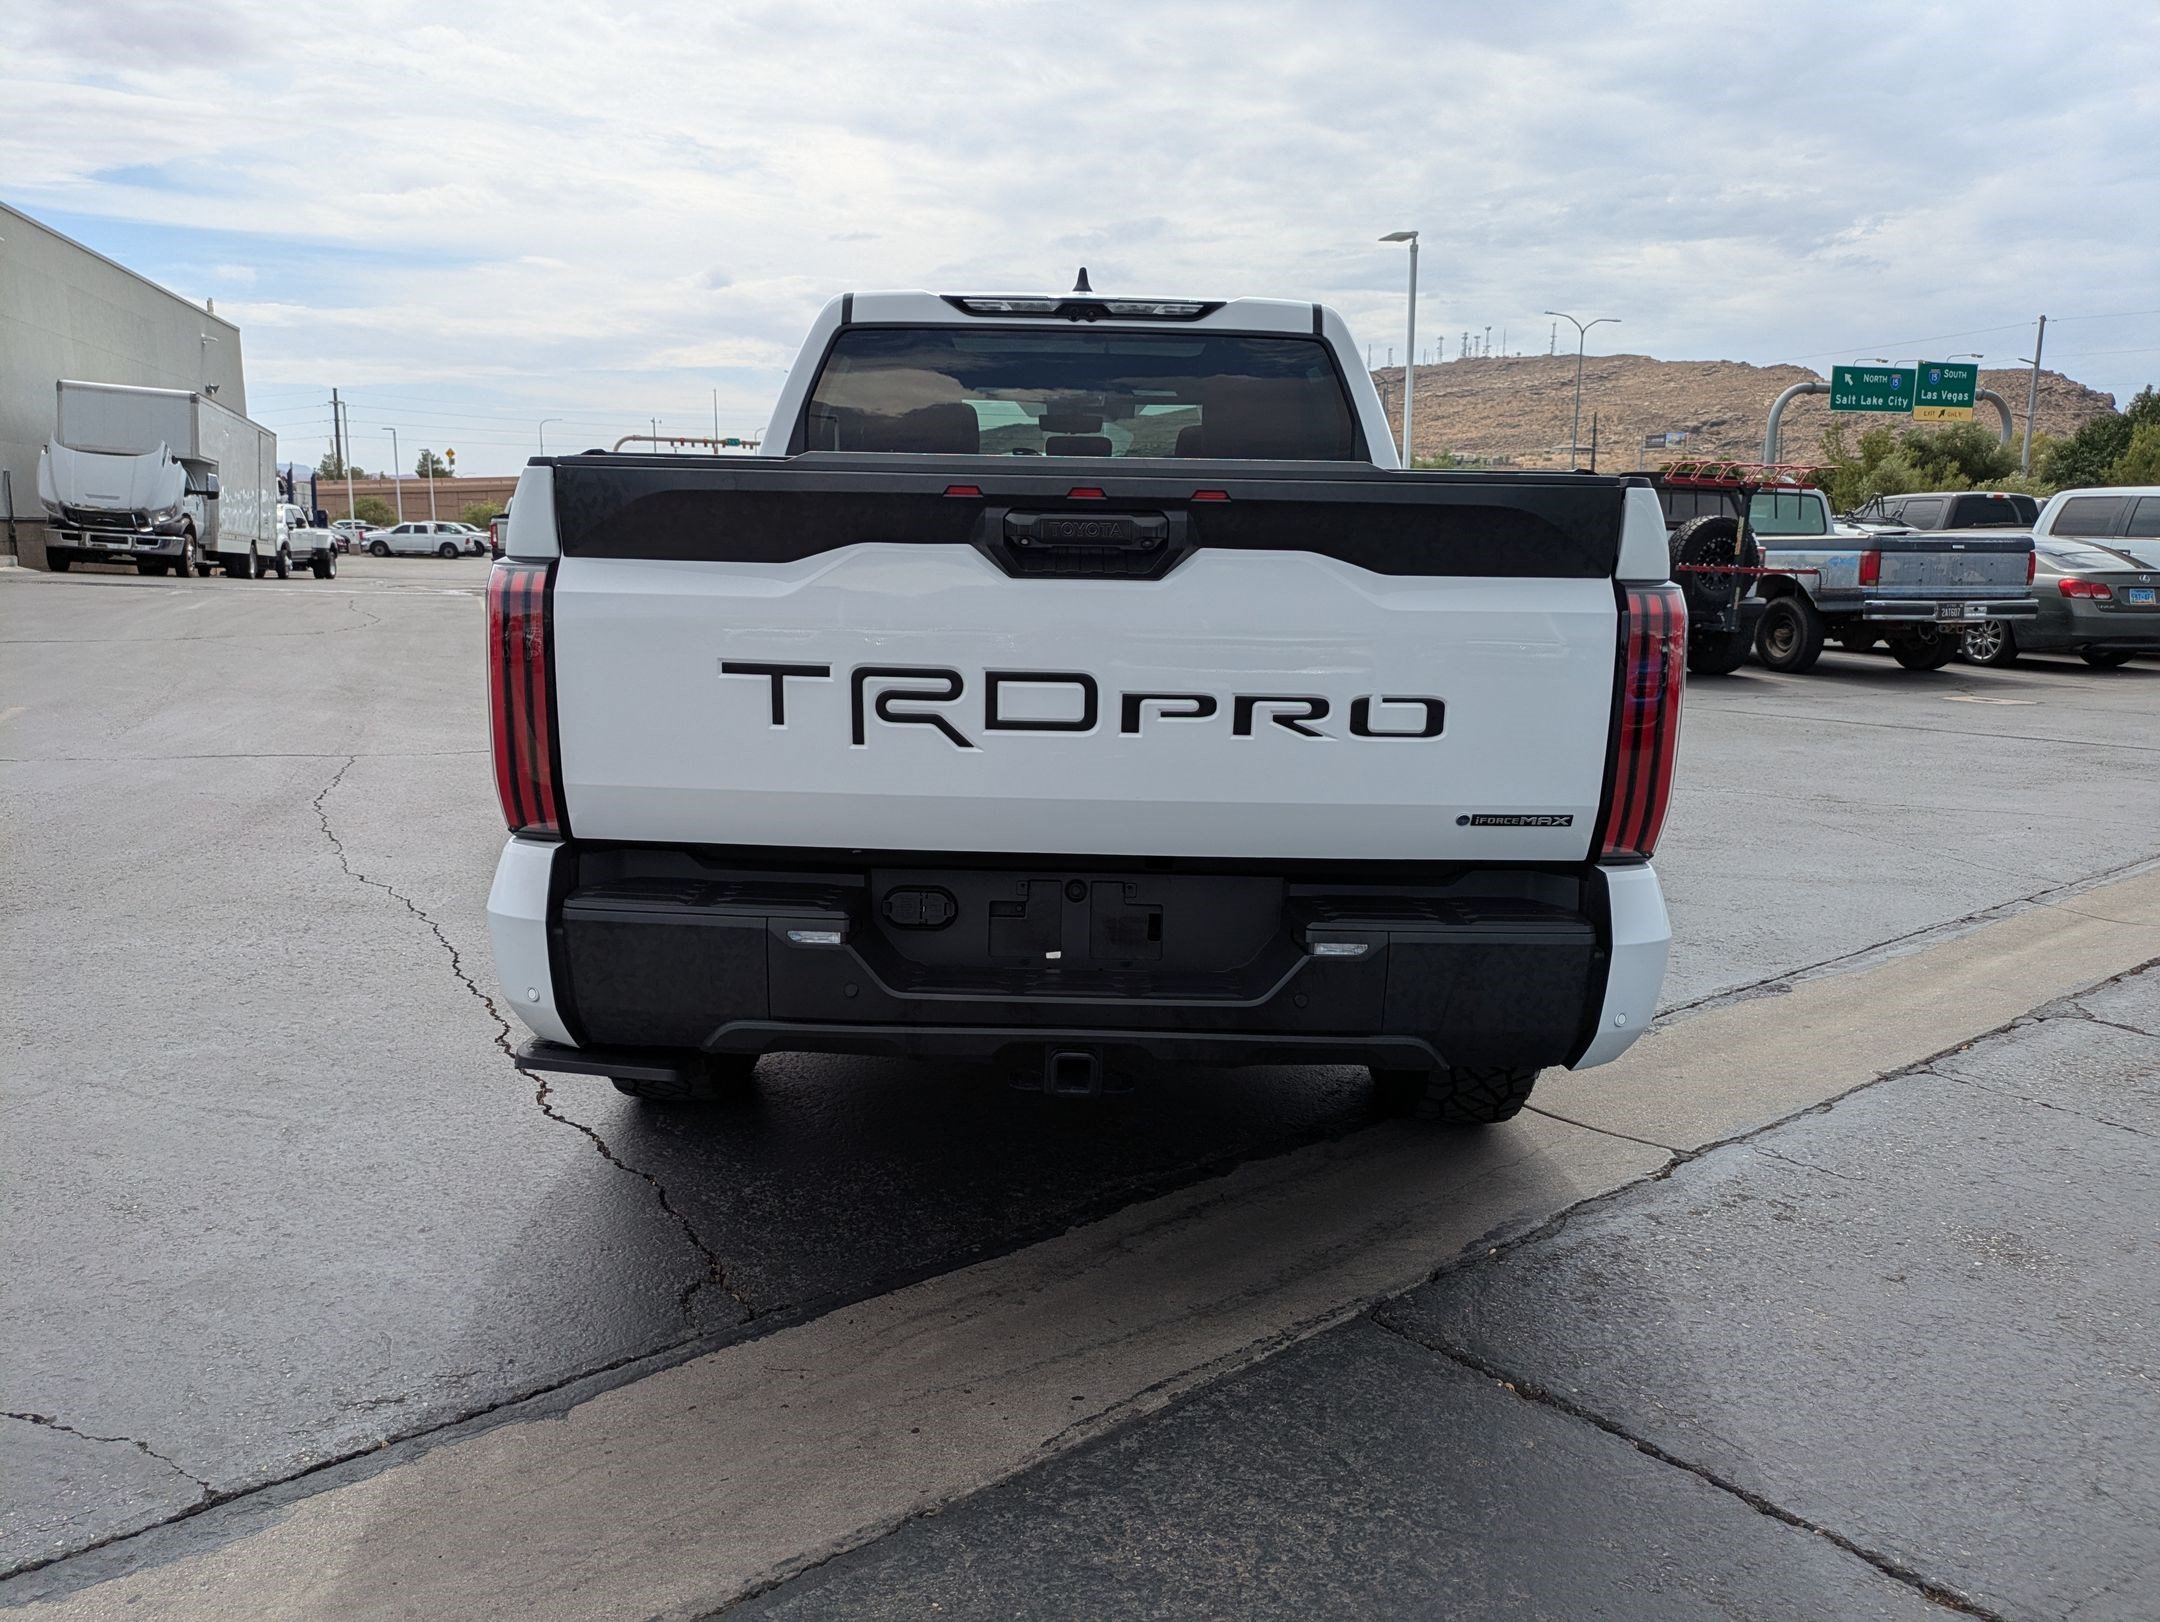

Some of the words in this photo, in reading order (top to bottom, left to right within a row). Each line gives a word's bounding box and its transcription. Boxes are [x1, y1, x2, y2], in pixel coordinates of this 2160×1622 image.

[1863, 373, 1888, 383] NORTH
[1892, 378, 1899, 386] 15
[1931, 373, 1938, 381] 15
[1943, 369, 1967, 379] SOUTH
[1835, 394, 1856, 405] Salt
[1860, 395, 1884, 405] Lake
[1888, 396, 1908, 408] City
[1921, 389, 1938, 400] Las
[1941, 390, 1969, 403] Vegas
[1049, 521, 1123, 538] TOYOTA
[720, 661, 1099, 750] TRD
[1119, 691, 1447, 741] PRO
